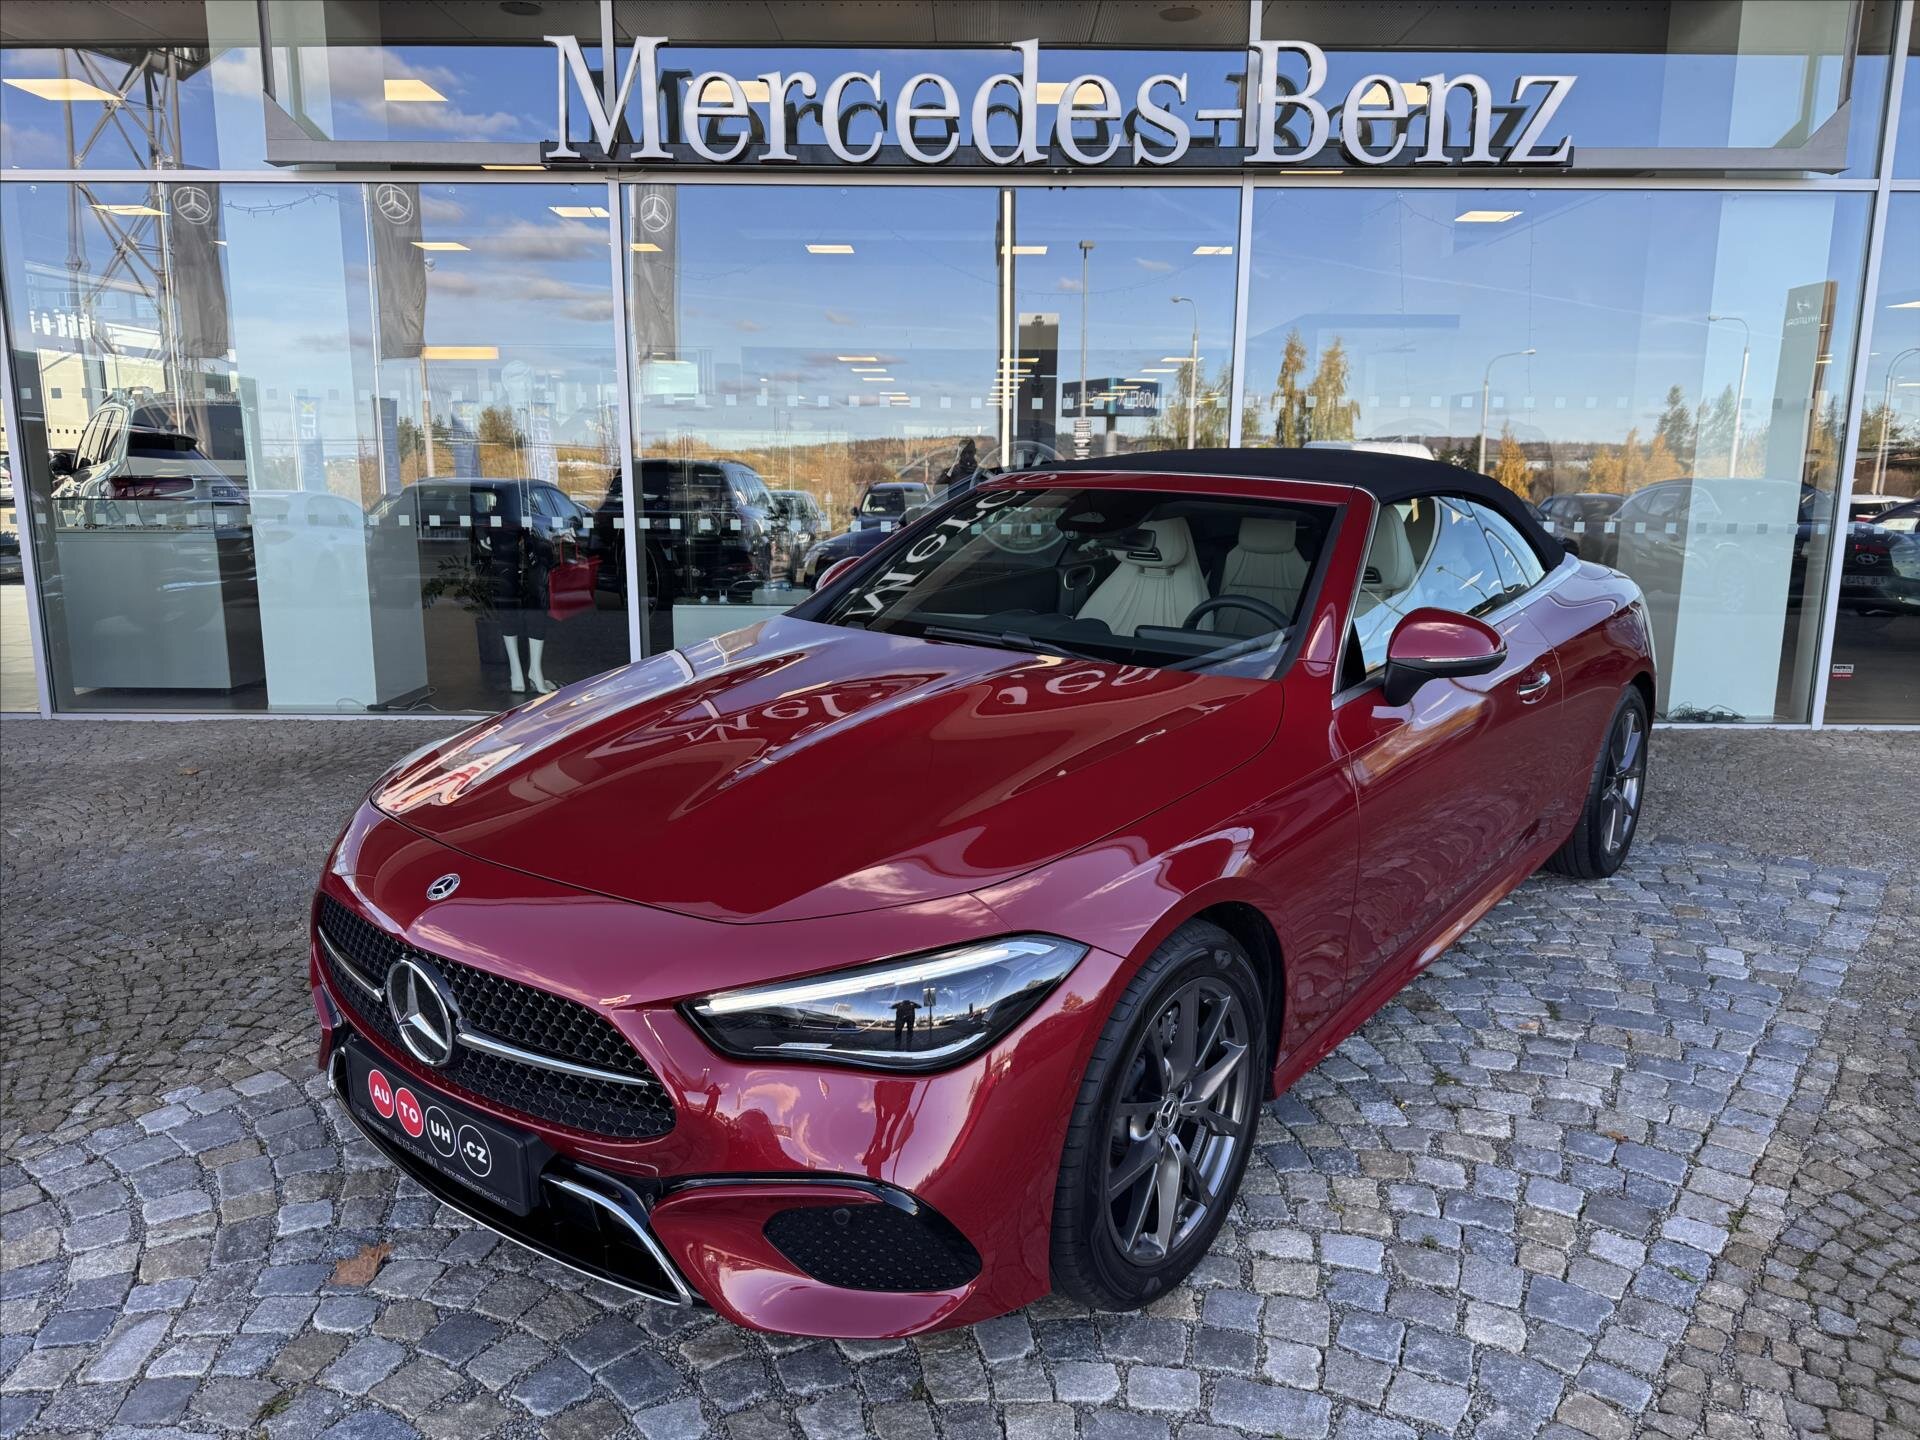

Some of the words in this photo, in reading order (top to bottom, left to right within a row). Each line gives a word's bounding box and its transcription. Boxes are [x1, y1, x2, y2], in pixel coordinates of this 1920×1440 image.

[543, 35, 1578, 166] Mercedes-Benz
[373, 1084, 390, 1105] AU
[400, 1102, 419, 1124] TO
[430, 1119, 451, 1144] UH
